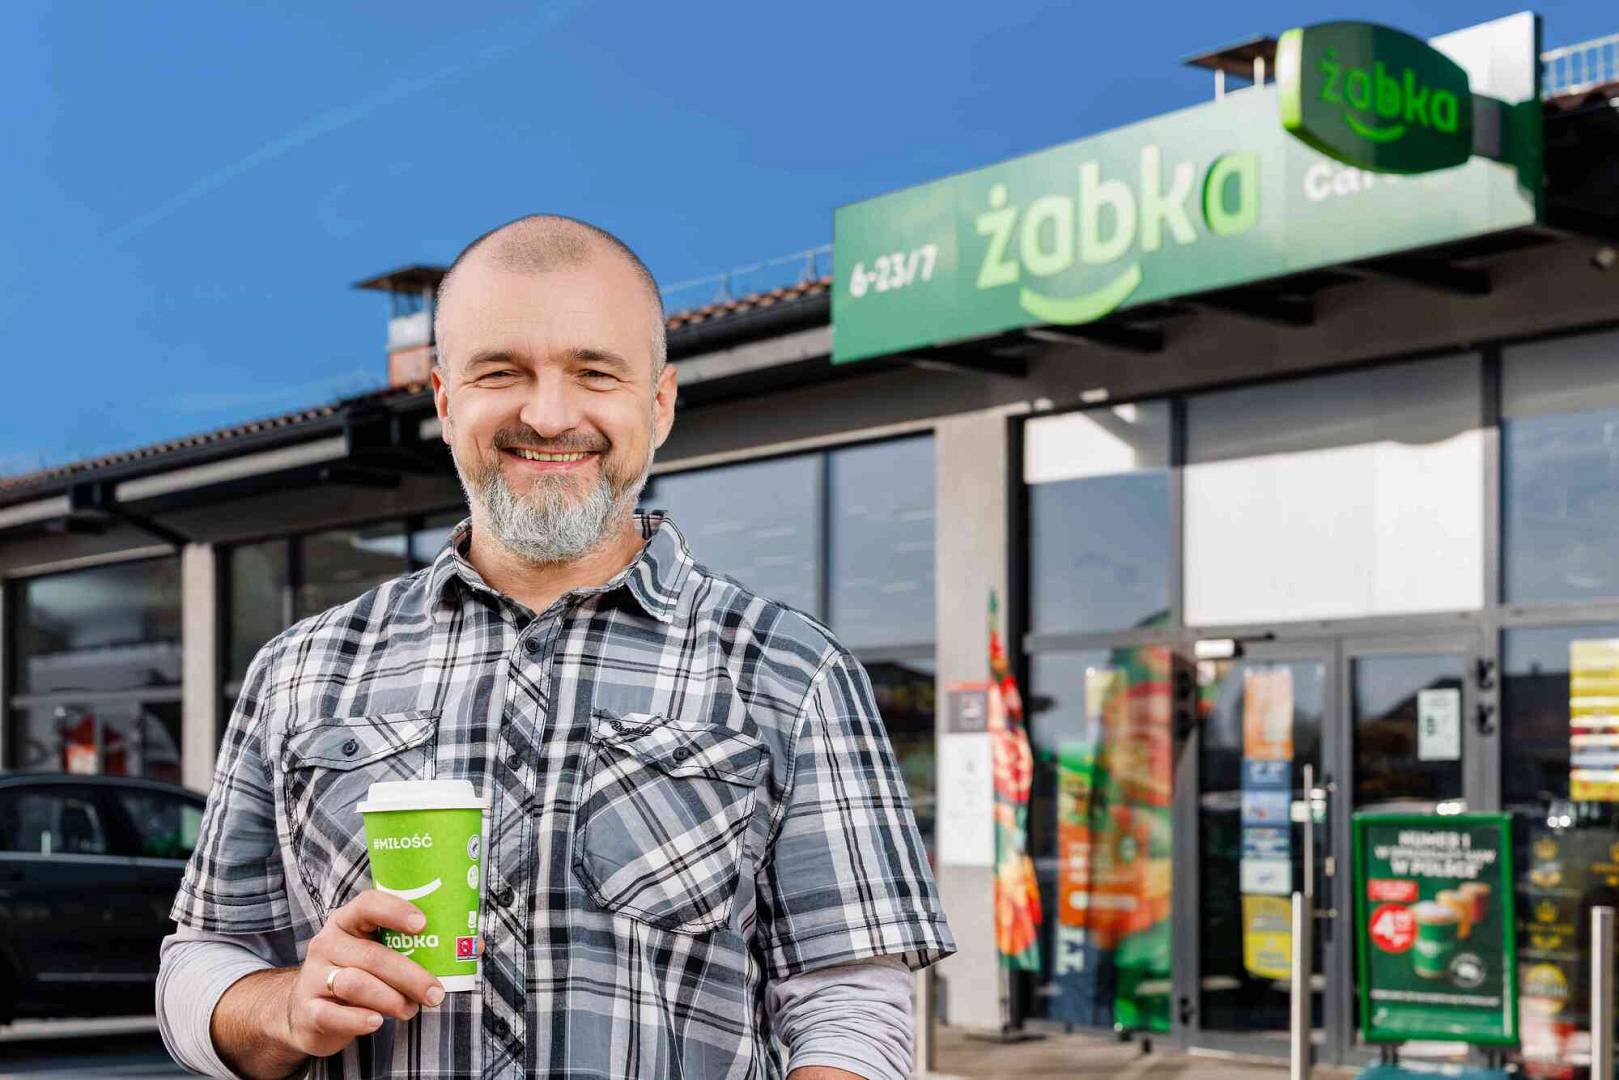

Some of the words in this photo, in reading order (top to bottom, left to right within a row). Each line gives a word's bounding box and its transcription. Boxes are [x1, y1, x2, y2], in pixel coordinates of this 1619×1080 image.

[1316, 47, 1459, 133] żabka
[850, 244, 937, 297] 6-23/7
[975, 143, 1261, 290] żabka
[373, 831, 433, 850] #MIŁOŚĆ
[384, 932, 440, 949] żabka
